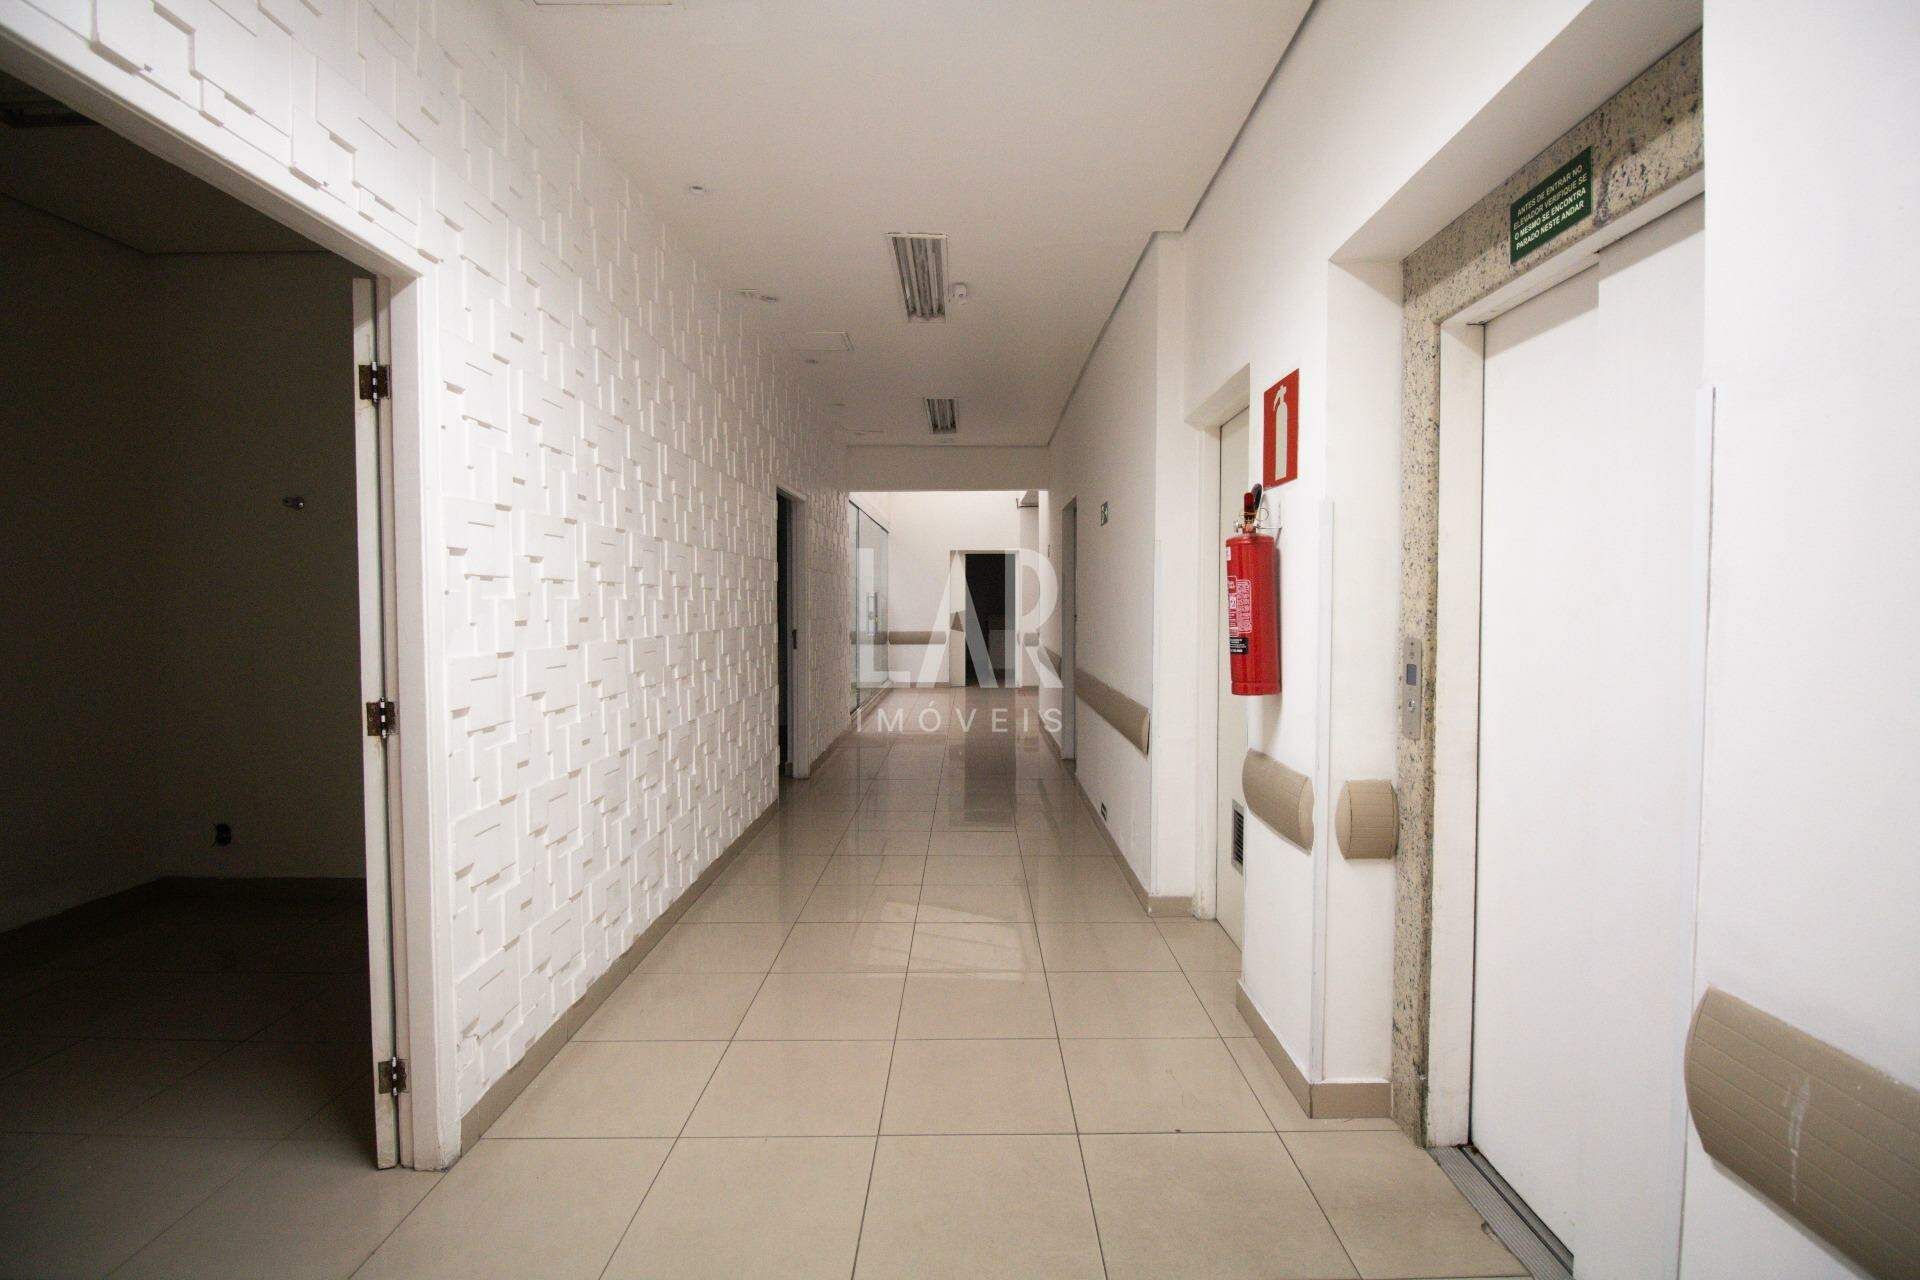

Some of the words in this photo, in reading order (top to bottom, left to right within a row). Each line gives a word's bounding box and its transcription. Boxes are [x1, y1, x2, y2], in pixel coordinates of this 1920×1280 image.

[1513, 204, 1544, 230] ELEVADOR
[1545, 181, 1577, 208] VERIFIQUE
[1578, 173, 1588, 185] SE
[1514, 232, 1520, 241] O
[1520, 217, 1541, 237] MESMO
[1542, 211, 1550, 221] SE
[1551, 187, 1586, 216] ENCONTRA
[1517, 197, 1536, 217] ANTES
[1536, 192, 1545, 203] DE
[1546, 173, 1571, 196] ENTRAR
[1572, 164, 1583, 177] NO
[1516, 230, 1540, 250] PARADO
[1540, 215, 1560, 235] NESTE
[1561, 200, 1584, 221] ANDAR
